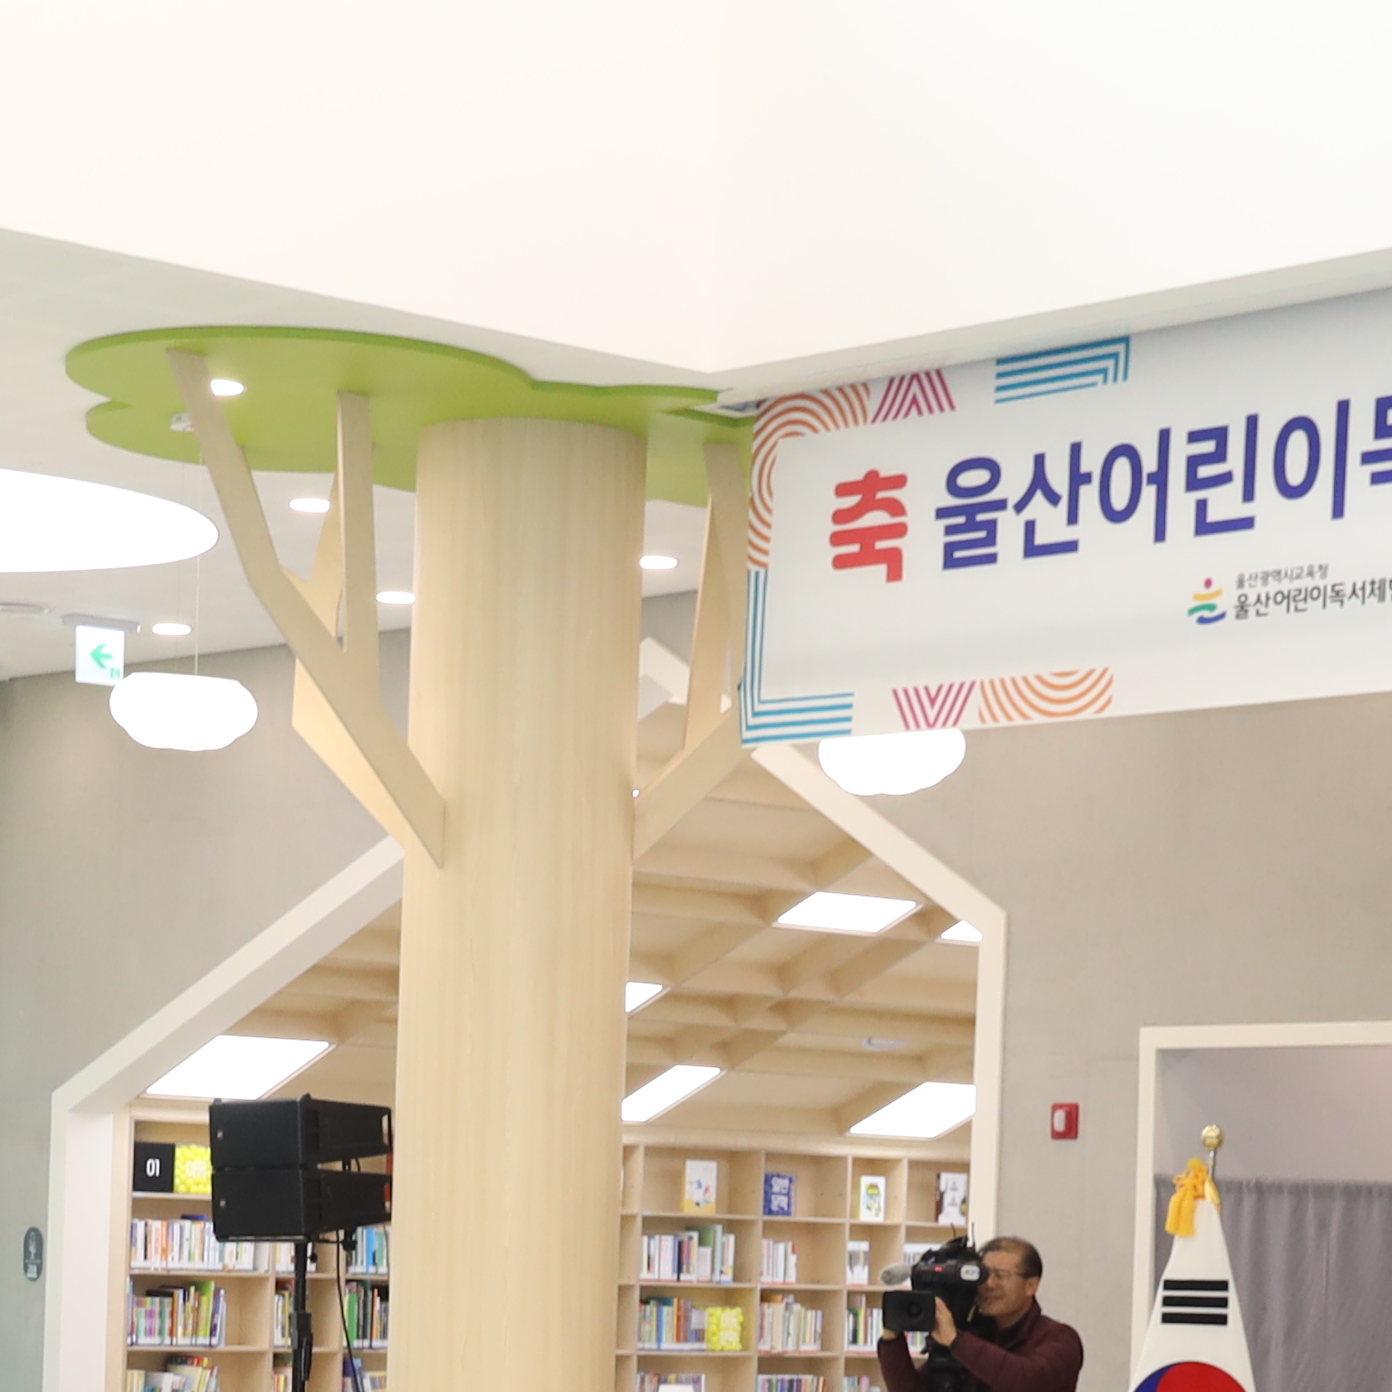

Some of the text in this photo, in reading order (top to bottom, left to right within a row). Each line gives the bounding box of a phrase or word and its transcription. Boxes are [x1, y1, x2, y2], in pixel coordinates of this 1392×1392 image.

[828, 468, 910, 584] 축
[1236, 563, 1329, 589] 울산광역시교육청
[145, 1158, 160, 1177] 01
